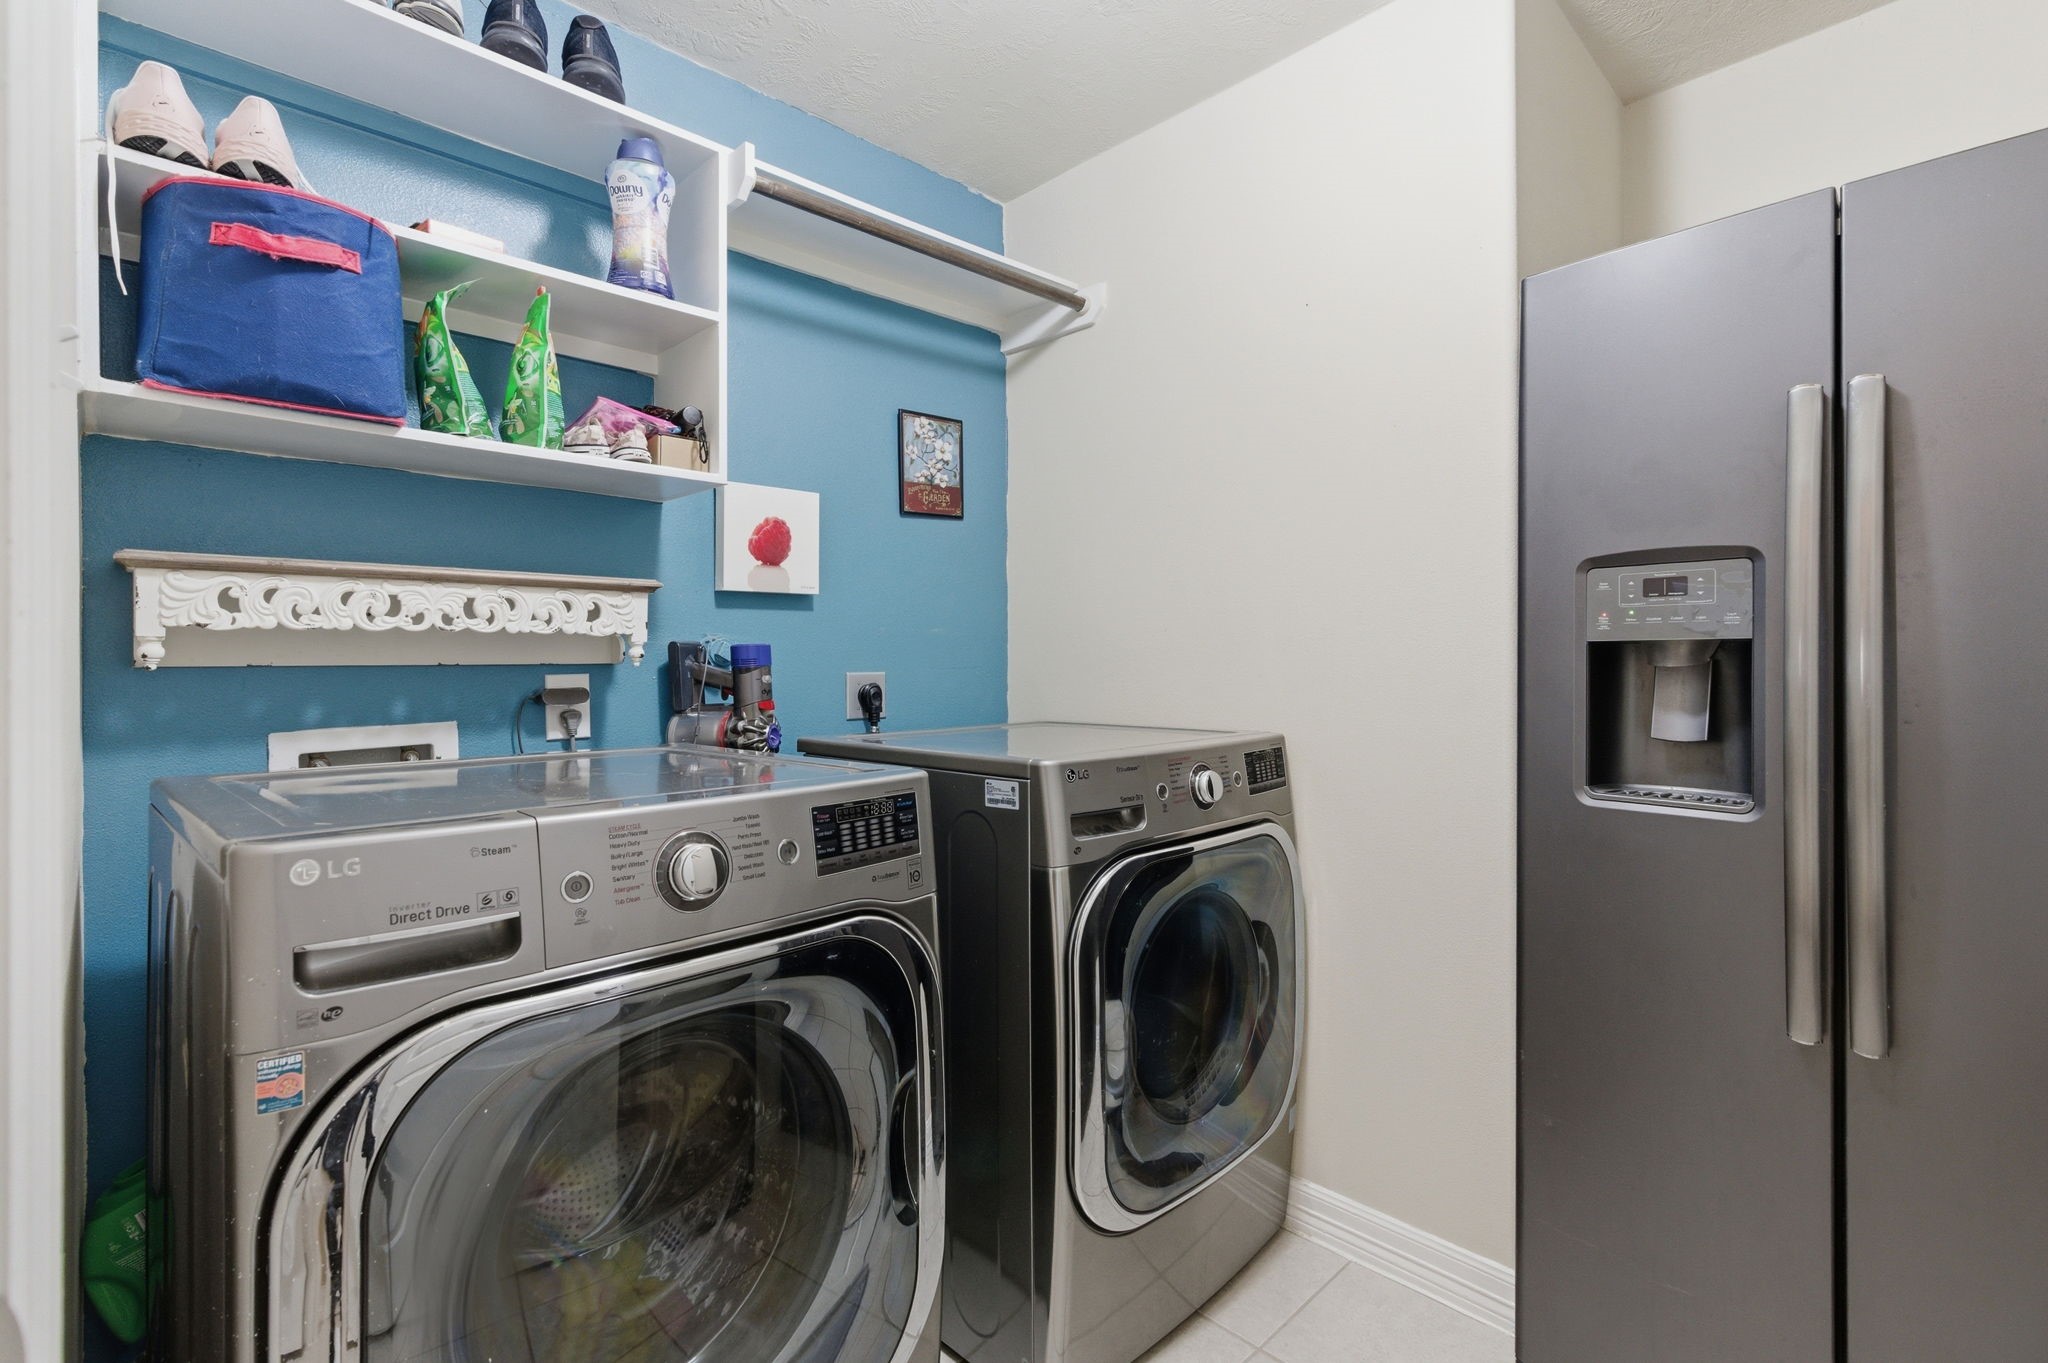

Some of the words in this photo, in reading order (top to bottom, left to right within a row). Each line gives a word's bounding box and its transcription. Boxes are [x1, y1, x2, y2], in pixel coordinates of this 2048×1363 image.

[609, 184, 643, 197] Downy
[1077, 769, 1090, 780] LG
[626, 823, 641, 831] CYCLE
[608, 829, 649, 840] Cotton/Normal
[480, 846, 512, 857] Steam
[327, 857, 361, 879] LG
[389, 909, 432, 926] Direct
[436, 904, 470, 918] Drive
[257, 1054, 302, 1070] CERTIFIED
